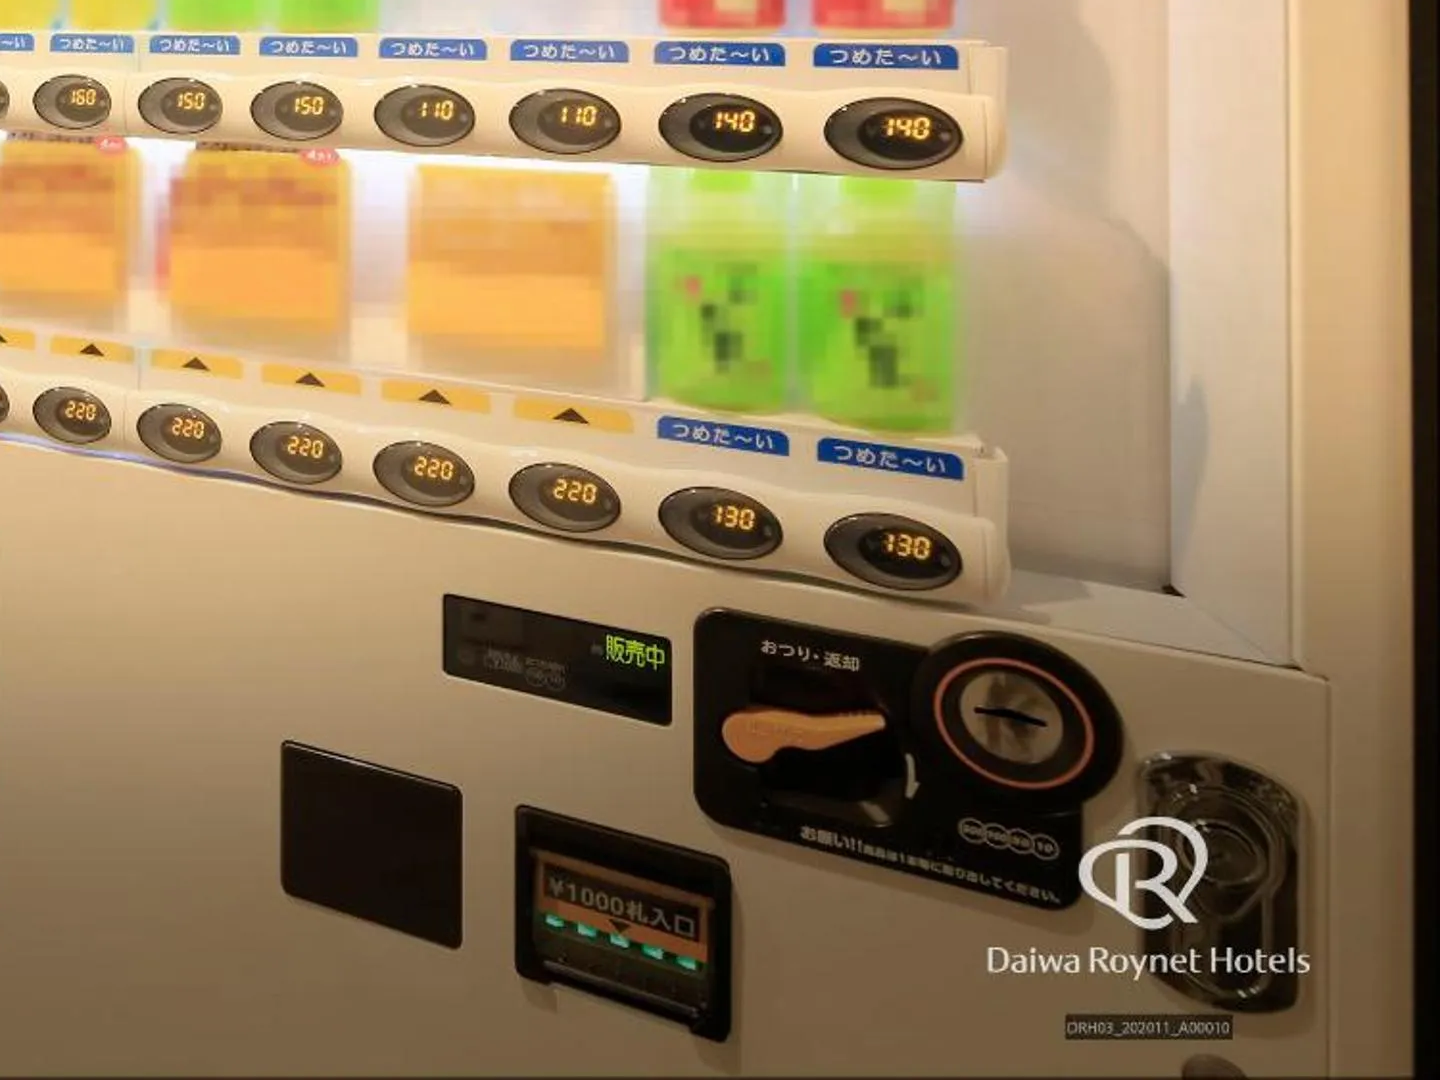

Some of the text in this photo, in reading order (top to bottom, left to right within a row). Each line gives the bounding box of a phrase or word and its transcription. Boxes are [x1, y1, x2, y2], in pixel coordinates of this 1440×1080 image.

[72, 89, 97, 106] 160
[178, 92, 205, 110] 150
[295, 96, 324, 116] 150
[422, 100, 453, 120] 110
[561, 106, 597, 126] 110
[715, 111, 754, 132] 140
[884, 117, 931, 140] 140
[65, 400, 97, 421] 220
[172, 416, 205, 439] 220
[287, 435, 324, 459] 220
[414, 456, 454, 481] 220
[554, 478, 597, 505] 220
[714, 505, 756, 531] 130
[886, 533, 932, 560] 130
[606, 634, 666, 671] 販売中
